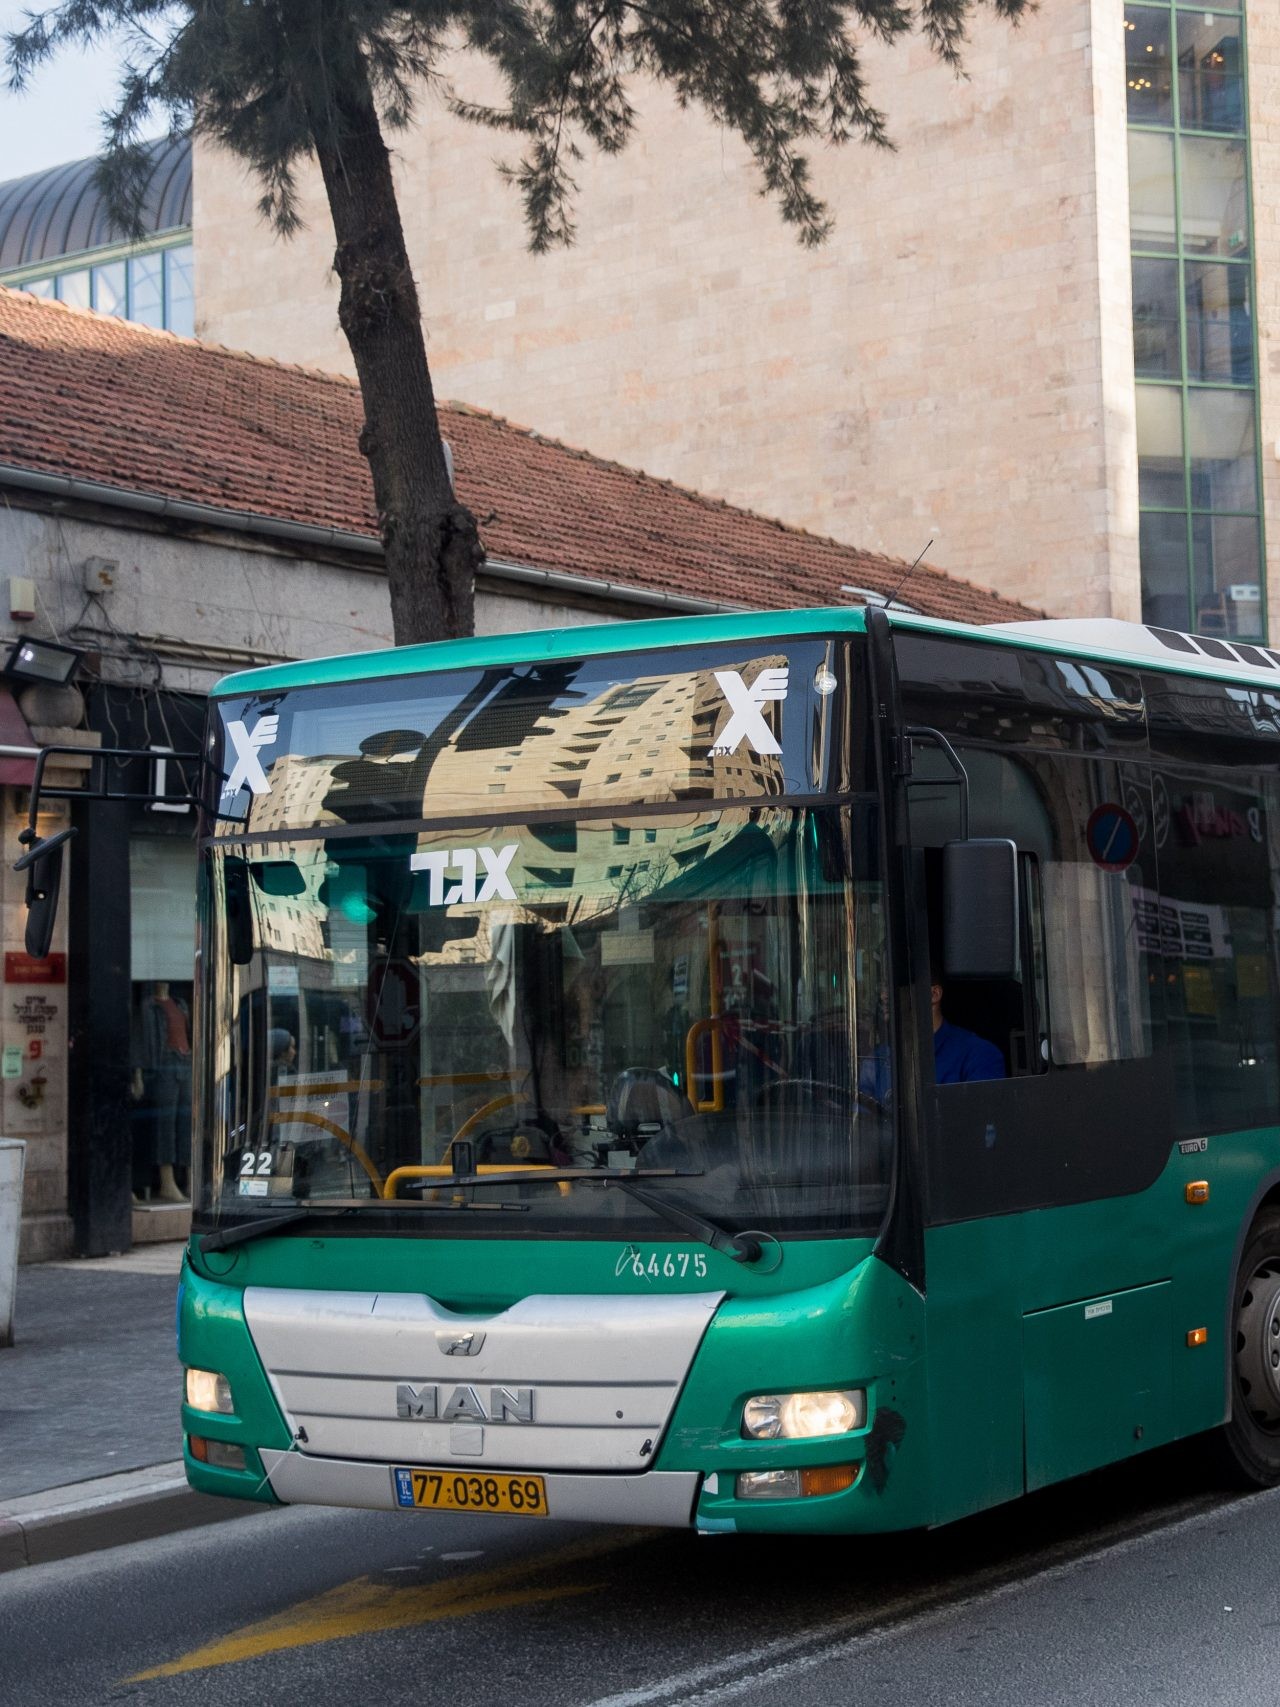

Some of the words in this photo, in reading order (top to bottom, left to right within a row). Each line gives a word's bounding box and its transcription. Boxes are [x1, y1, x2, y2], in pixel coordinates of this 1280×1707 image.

[410, 844, 520, 907] אגד
[1181, 1142, 1199, 1154] EURO
[240, 1152, 272, 1175] 22
[632, 1253, 707, 1278] 64675
[396, 1384, 535, 1423] MAN
